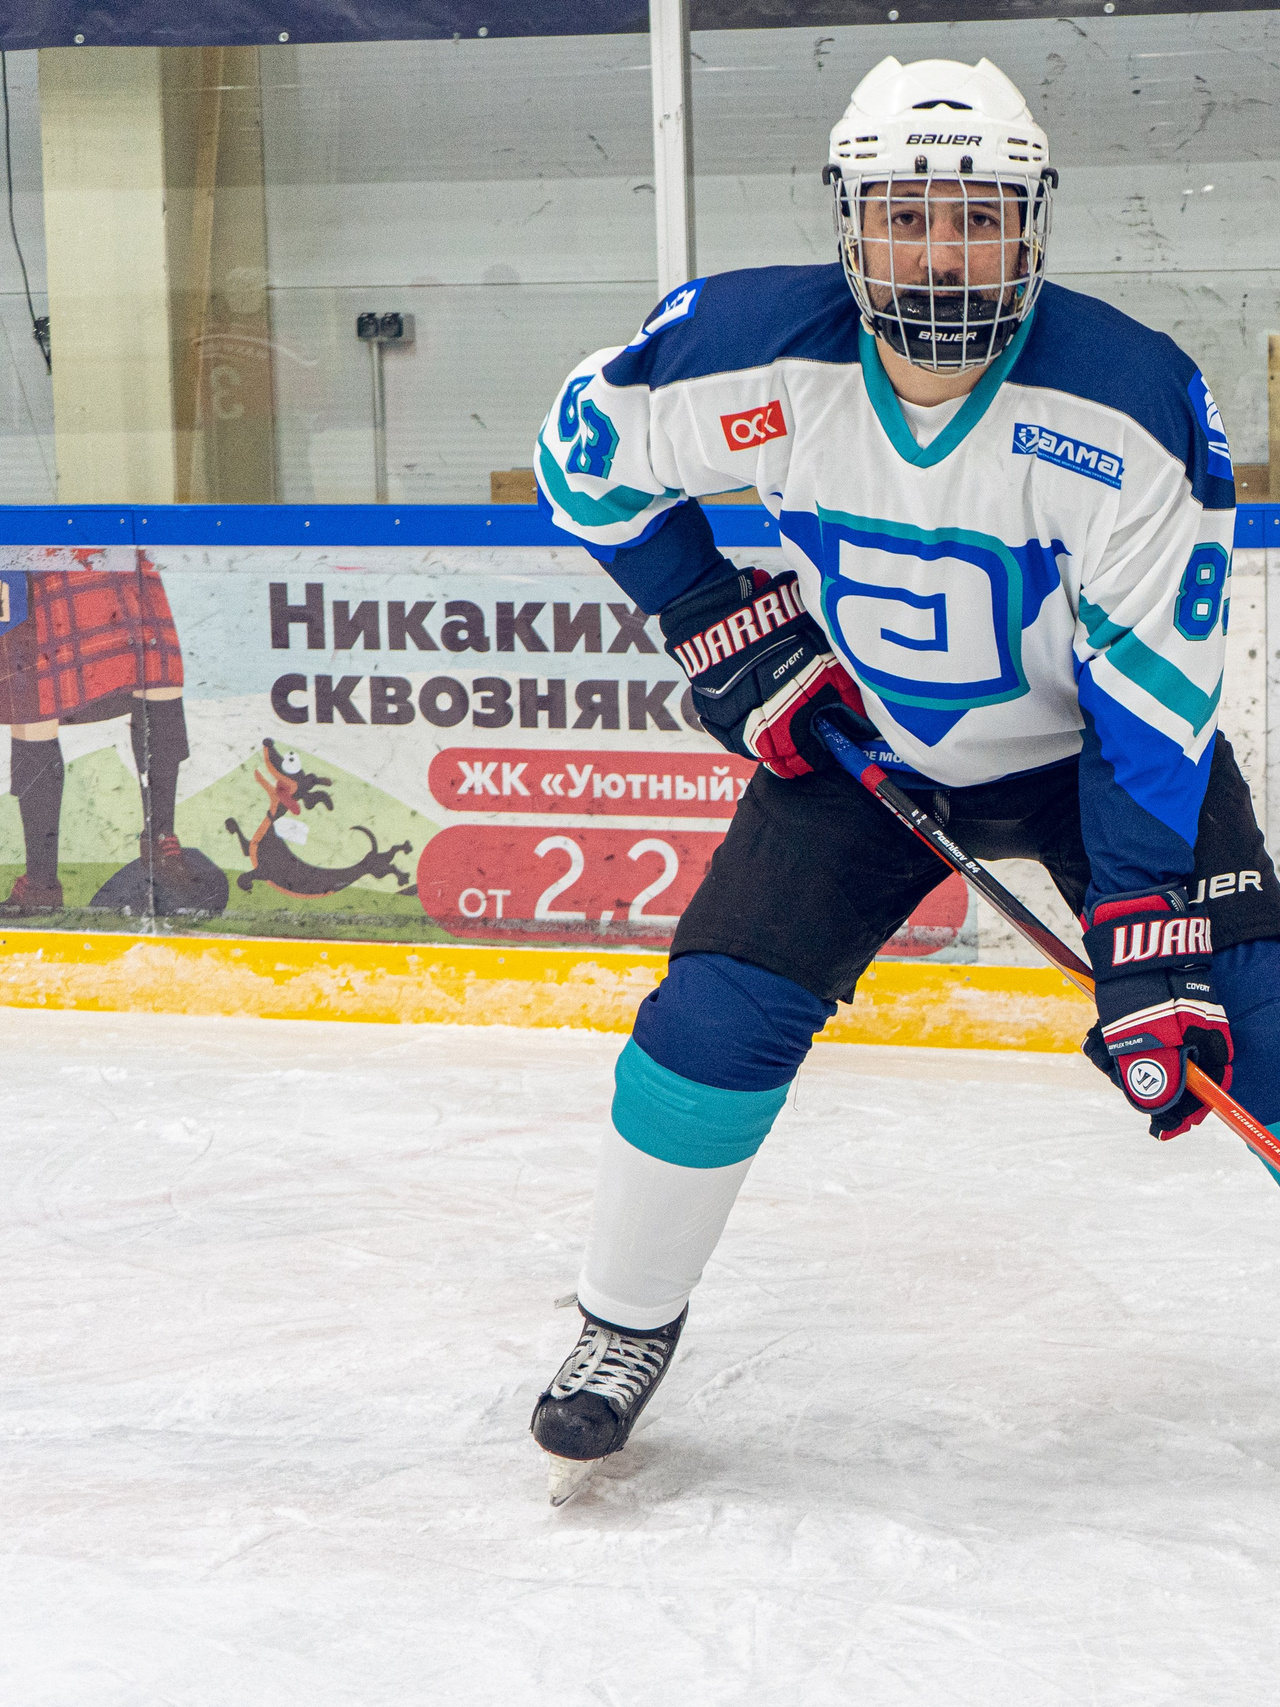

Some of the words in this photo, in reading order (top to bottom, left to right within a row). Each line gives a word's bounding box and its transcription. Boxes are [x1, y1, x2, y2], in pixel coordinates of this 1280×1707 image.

[906, 133, 983, 147] BAUER
[918, 329, 978, 342] BAUER
[1173, 541, 1232, 641] 8
[268, 582, 666, 655] Никаких
[772, 647, 804, 680] COVERT
[456, 761, 530, 797] ЖК
[932, 829, 968, 863] Pashkov
[458, 888, 511, 919] от
[1185, 870, 1264, 904] UER
[1186, 981, 1211, 993] COVERT
